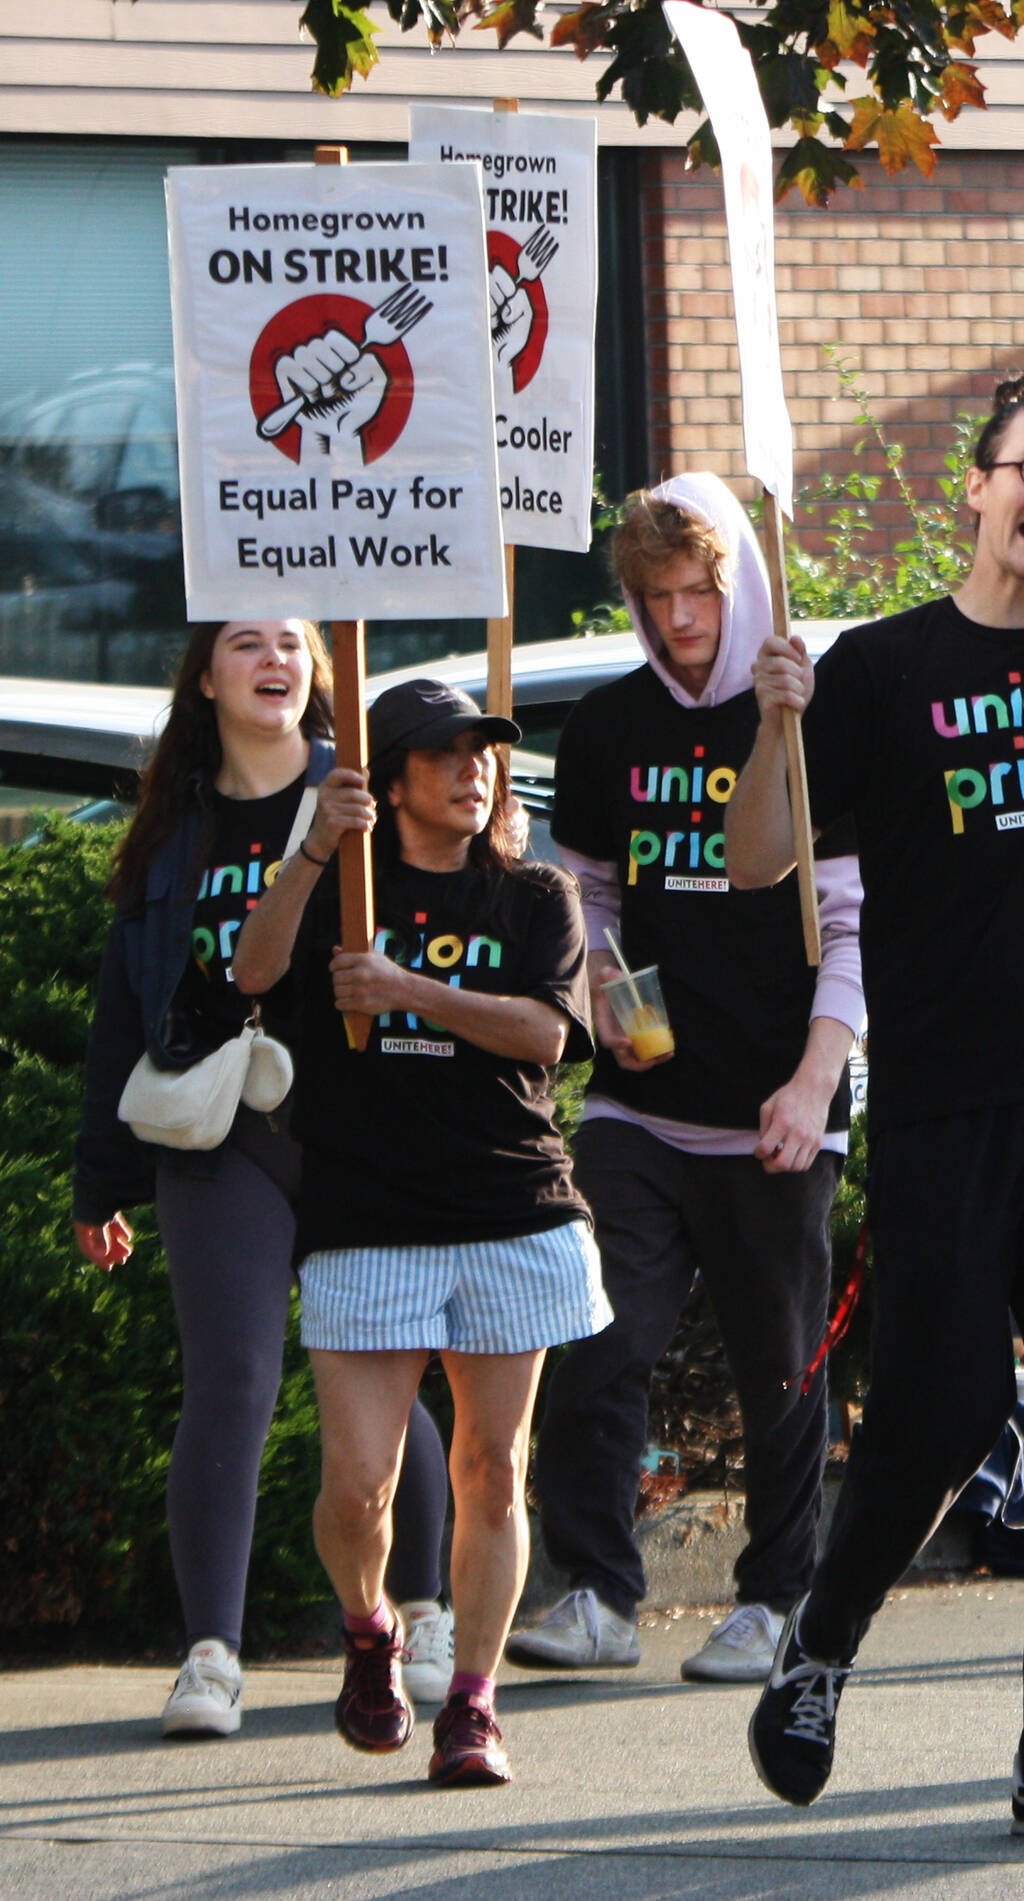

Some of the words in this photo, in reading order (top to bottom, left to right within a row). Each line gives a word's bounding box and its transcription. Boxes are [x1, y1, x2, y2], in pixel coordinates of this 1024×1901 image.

[440, 145, 556, 178] Hegrown
[228, 206, 425, 238] Homegrown
[486, 188, 568, 225] TRIKE!
[208, 248, 273, 284] ON
[284, 245, 449, 284] STRIKE!
[219, 478, 317, 520] Equal
[331, 479, 397, 520] Pay
[409, 476, 463, 509] for
[237, 535, 337, 577] Equal
[349, 534, 452, 567] Work
[630, 746, 737, 804] unio
[667, 877, 727, 891] UNITEHERE!
